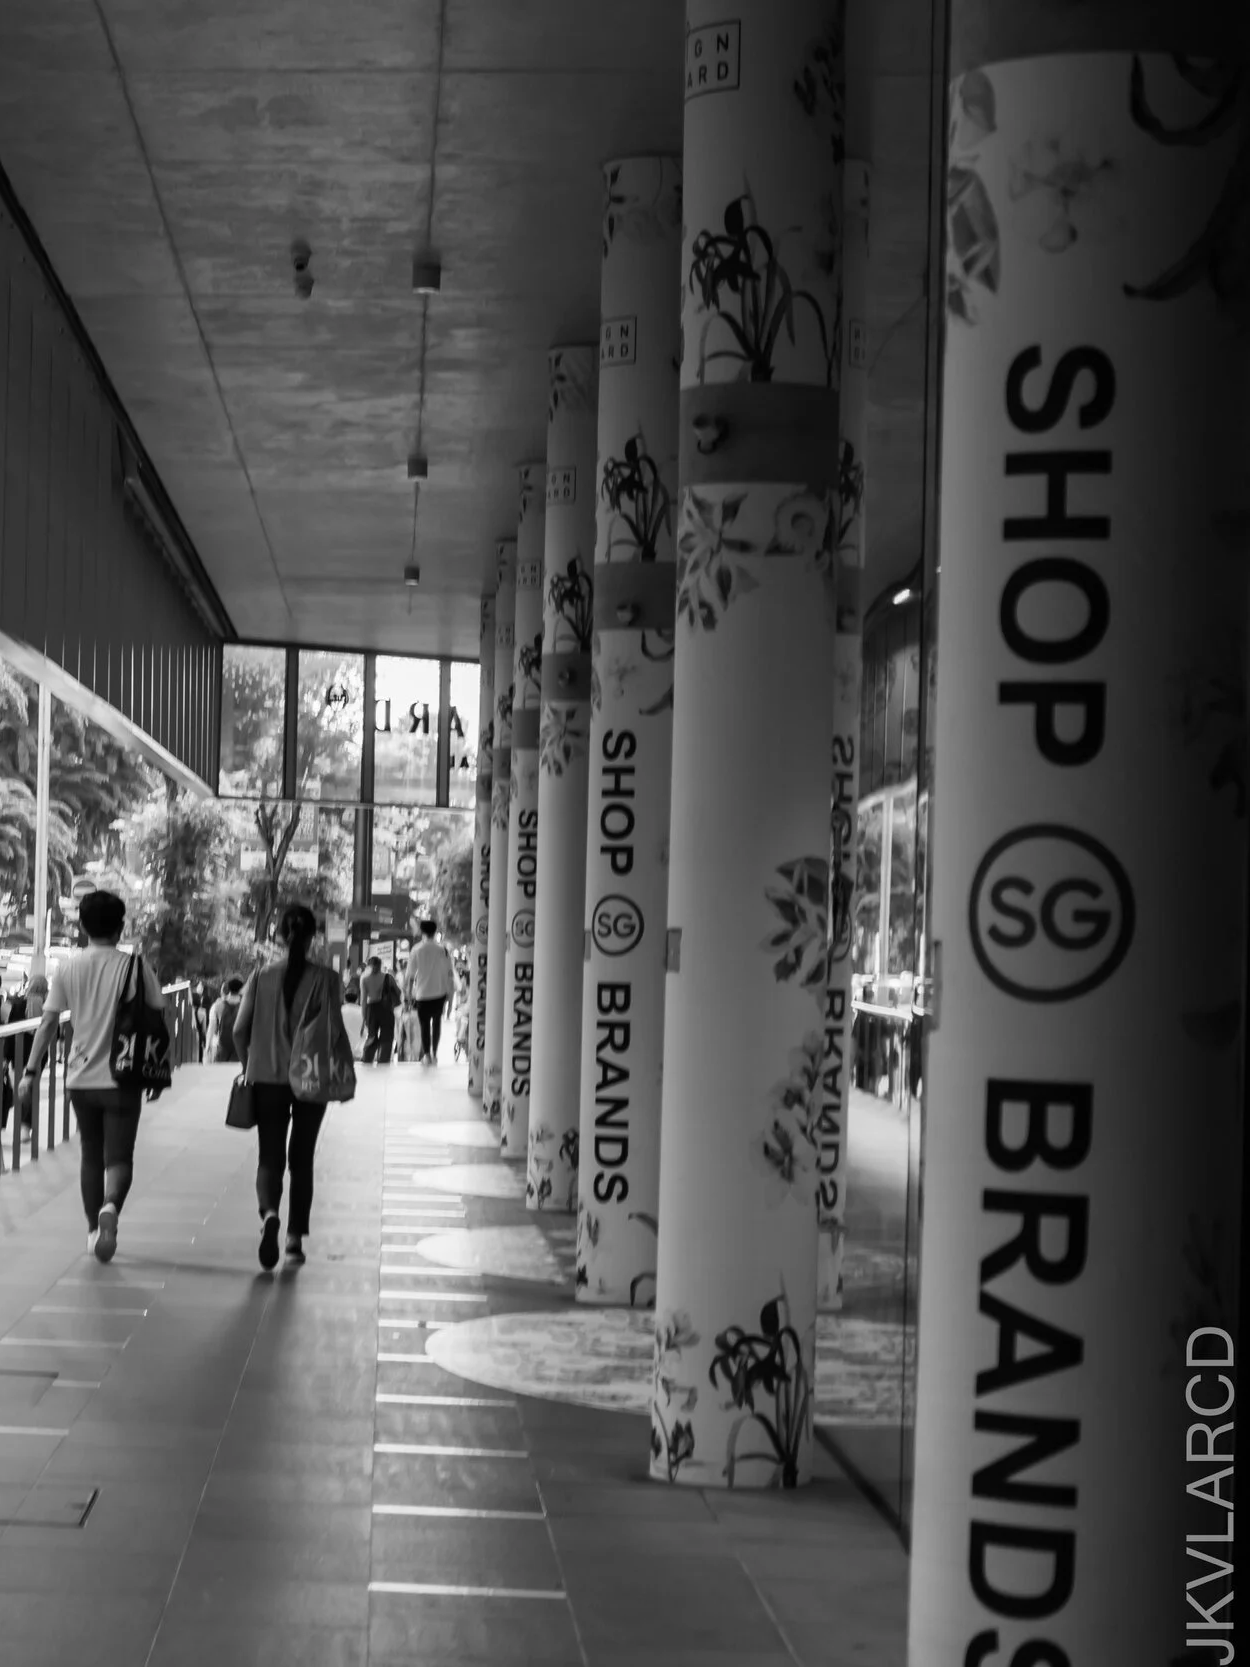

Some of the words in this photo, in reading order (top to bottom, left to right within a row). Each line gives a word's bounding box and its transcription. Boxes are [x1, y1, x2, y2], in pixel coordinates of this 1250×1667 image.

[998, 343, 1116, 767] SHOP
[517, 809, 538, 899] SHOP
[599, 728, 636, 877] SHOP
[597, 911, 637, 938] SG
[987, 875, 1112, 951] SG
[511, 962, 534, 1097] BRANDS
[593, 981, 632, 1206] BRANDS
